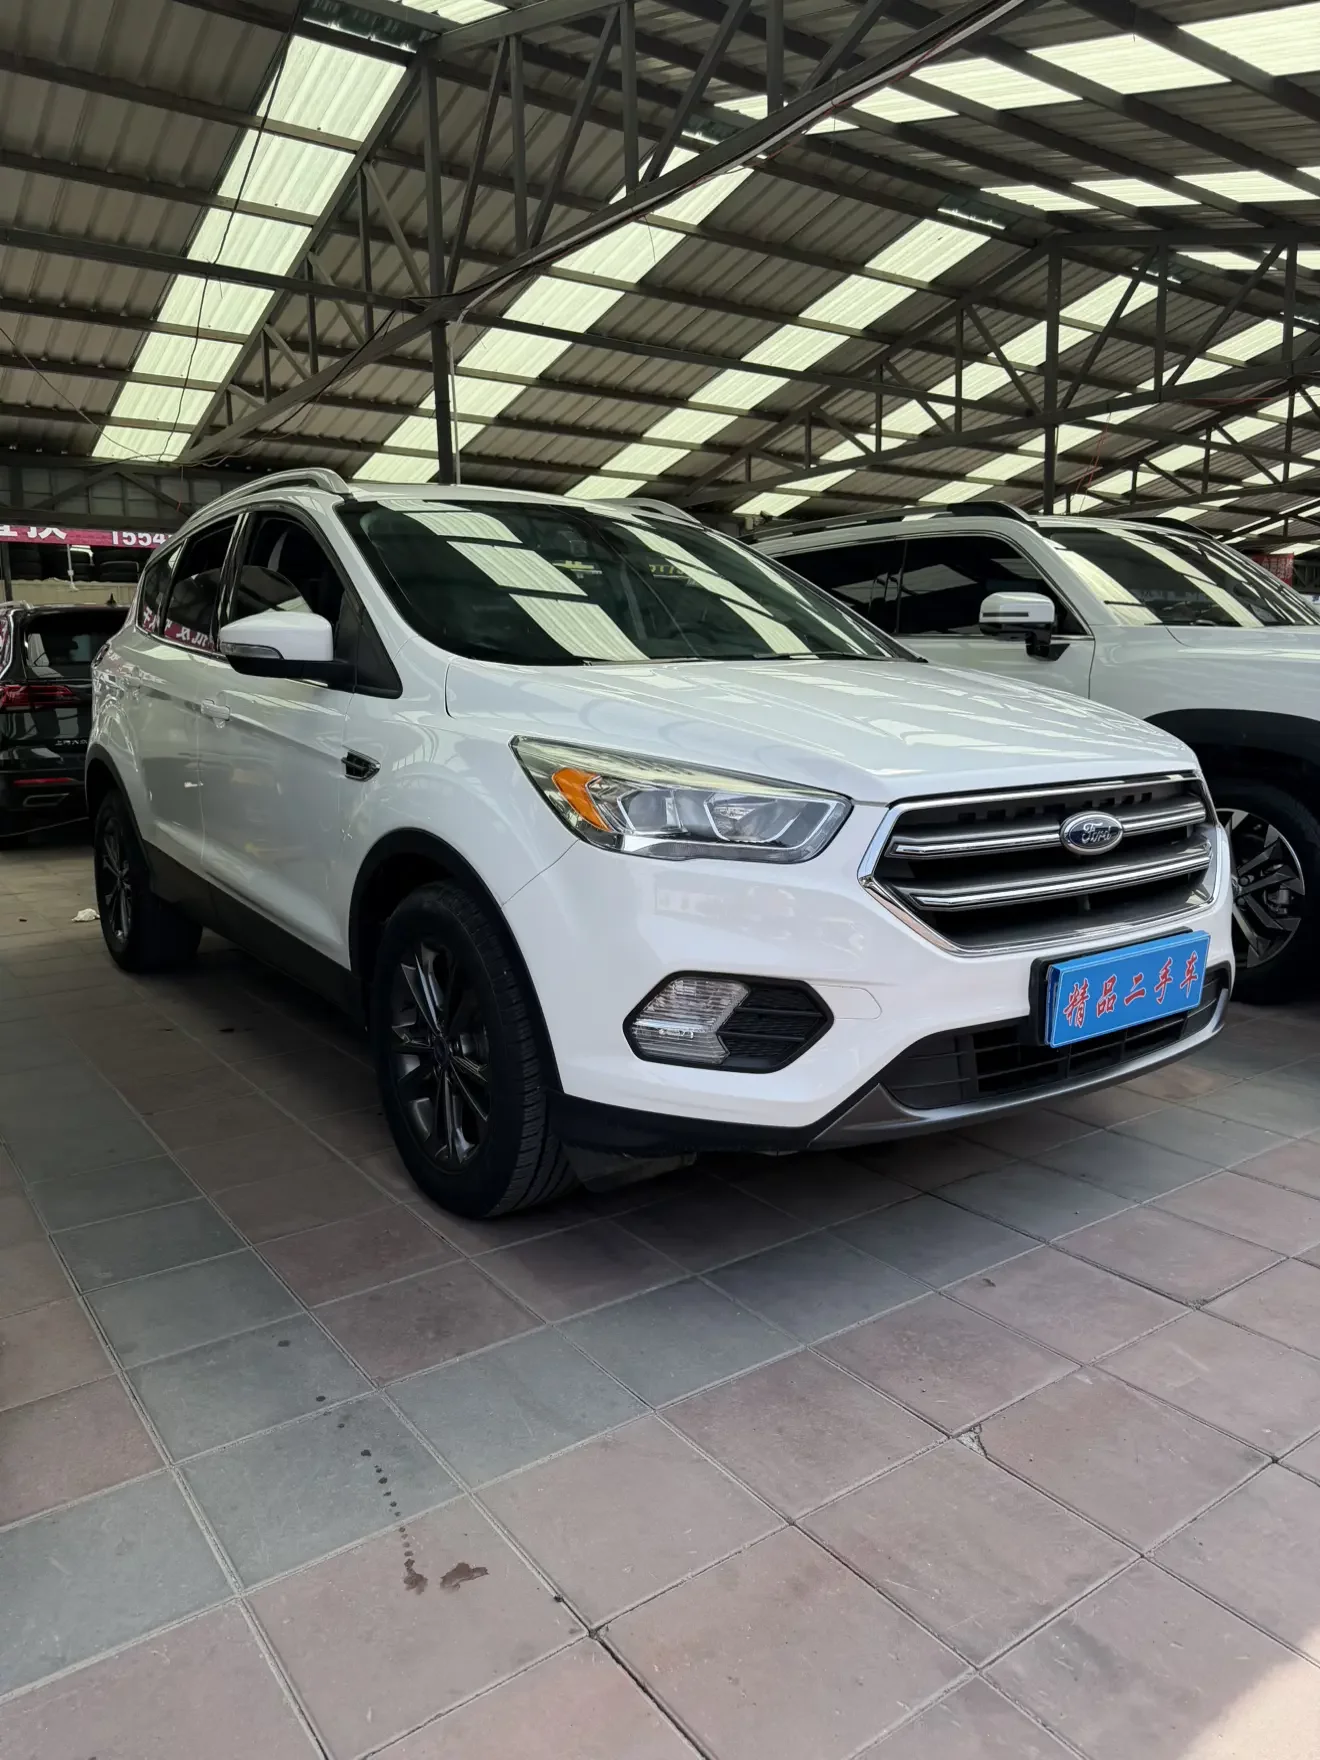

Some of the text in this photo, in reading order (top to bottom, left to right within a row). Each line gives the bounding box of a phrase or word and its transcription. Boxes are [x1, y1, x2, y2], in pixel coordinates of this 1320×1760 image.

[113, 531, 172, 547] 1554
[1081, 822, 1111, 844] Ford
[1063, 950, 1198, 1028] 精品二手车
